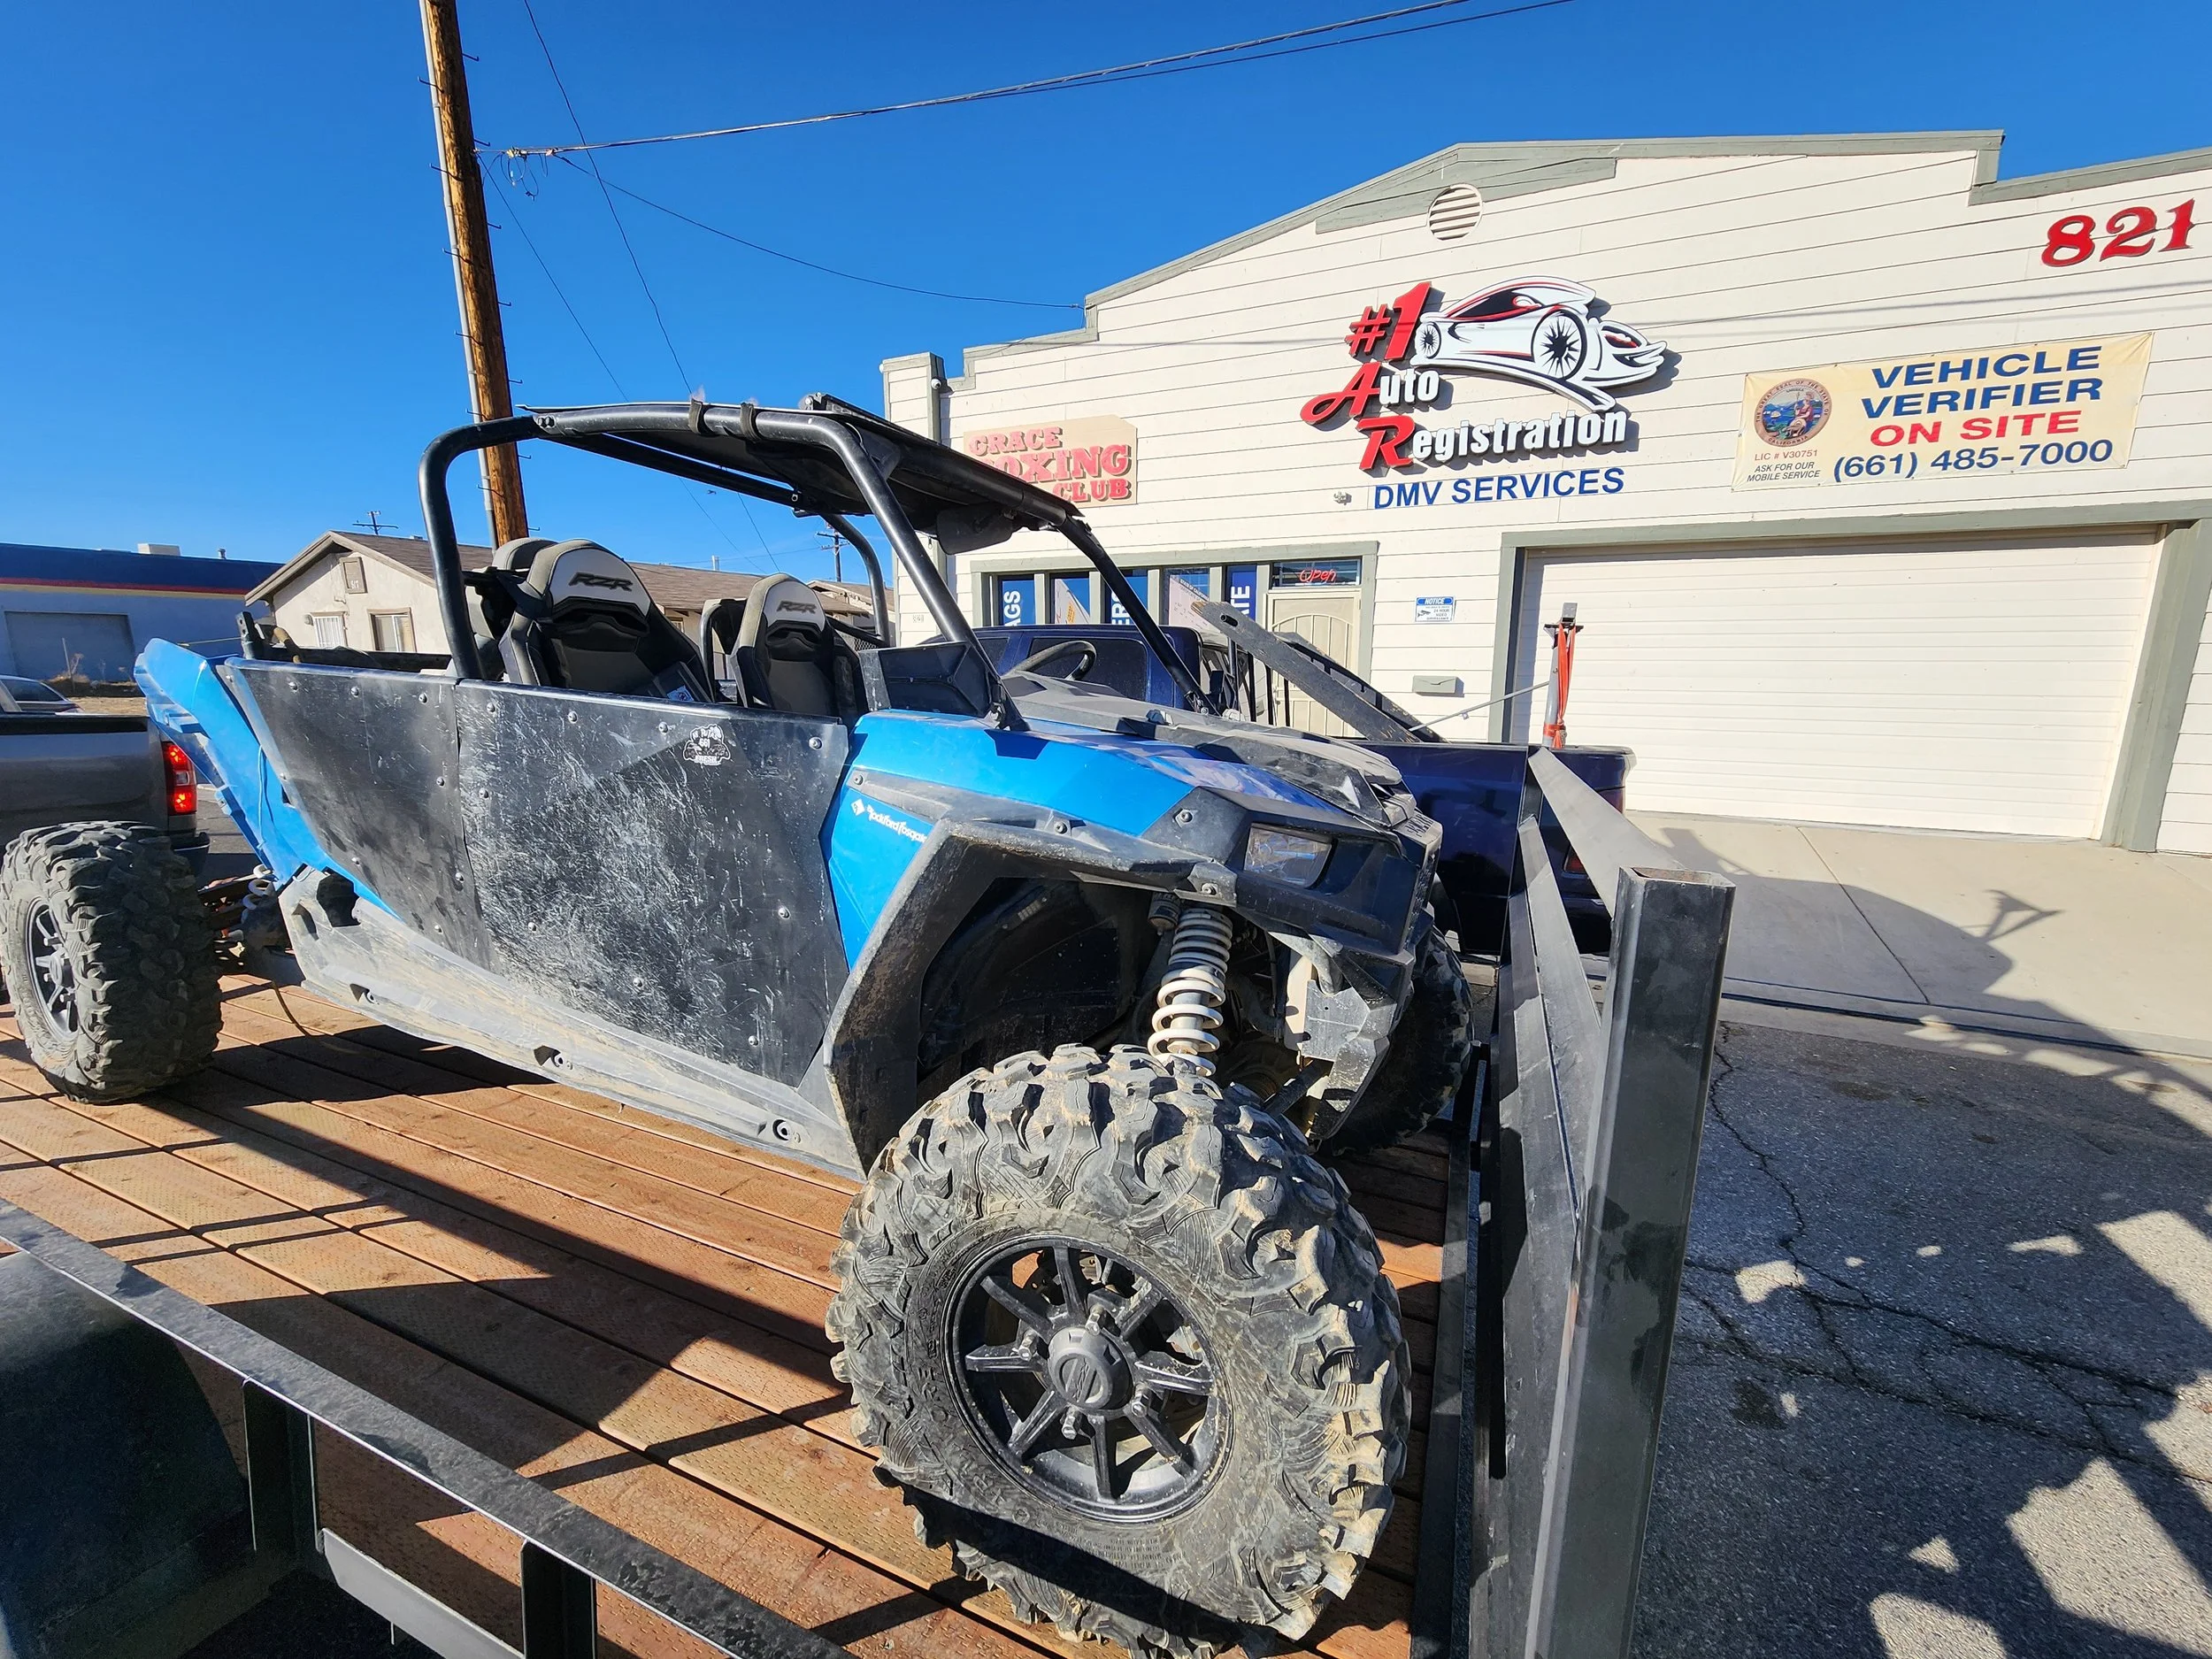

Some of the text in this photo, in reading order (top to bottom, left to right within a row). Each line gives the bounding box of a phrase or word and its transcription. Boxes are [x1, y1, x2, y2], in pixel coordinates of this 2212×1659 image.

[2041, 197, 2195, 267] 821
[1345, 281, 1432, 361] #1
[1871, 346, 2103, 388] VEHICLE
[1301, 362, 1440, 423] Auto
[1862, 377, 2103, 419] VERIFIER
[969, 426, 1062, 456] GRACE
[1357, 411, 1627, 471] Registration
[1870, 410, 2082, 447] ON SITE
[979, 444, 1131, 483] OXING
[1774, 463, 1793, 472] FOR
[1783, 449, 1817, 459] V30751
[1834, 439, 2113, 483] (661) 485-7000
[1052, 478, 1132, 503] CLUB
[1374, 467, 1625, 510] DMV SERVICES
[1747, 470, 1821, 482] MOBILE SERVICE
[568, 572, 634, 591] RZR
[1300, 569, 1336, 583] Open
[777, 600, 818, 614] RZR
